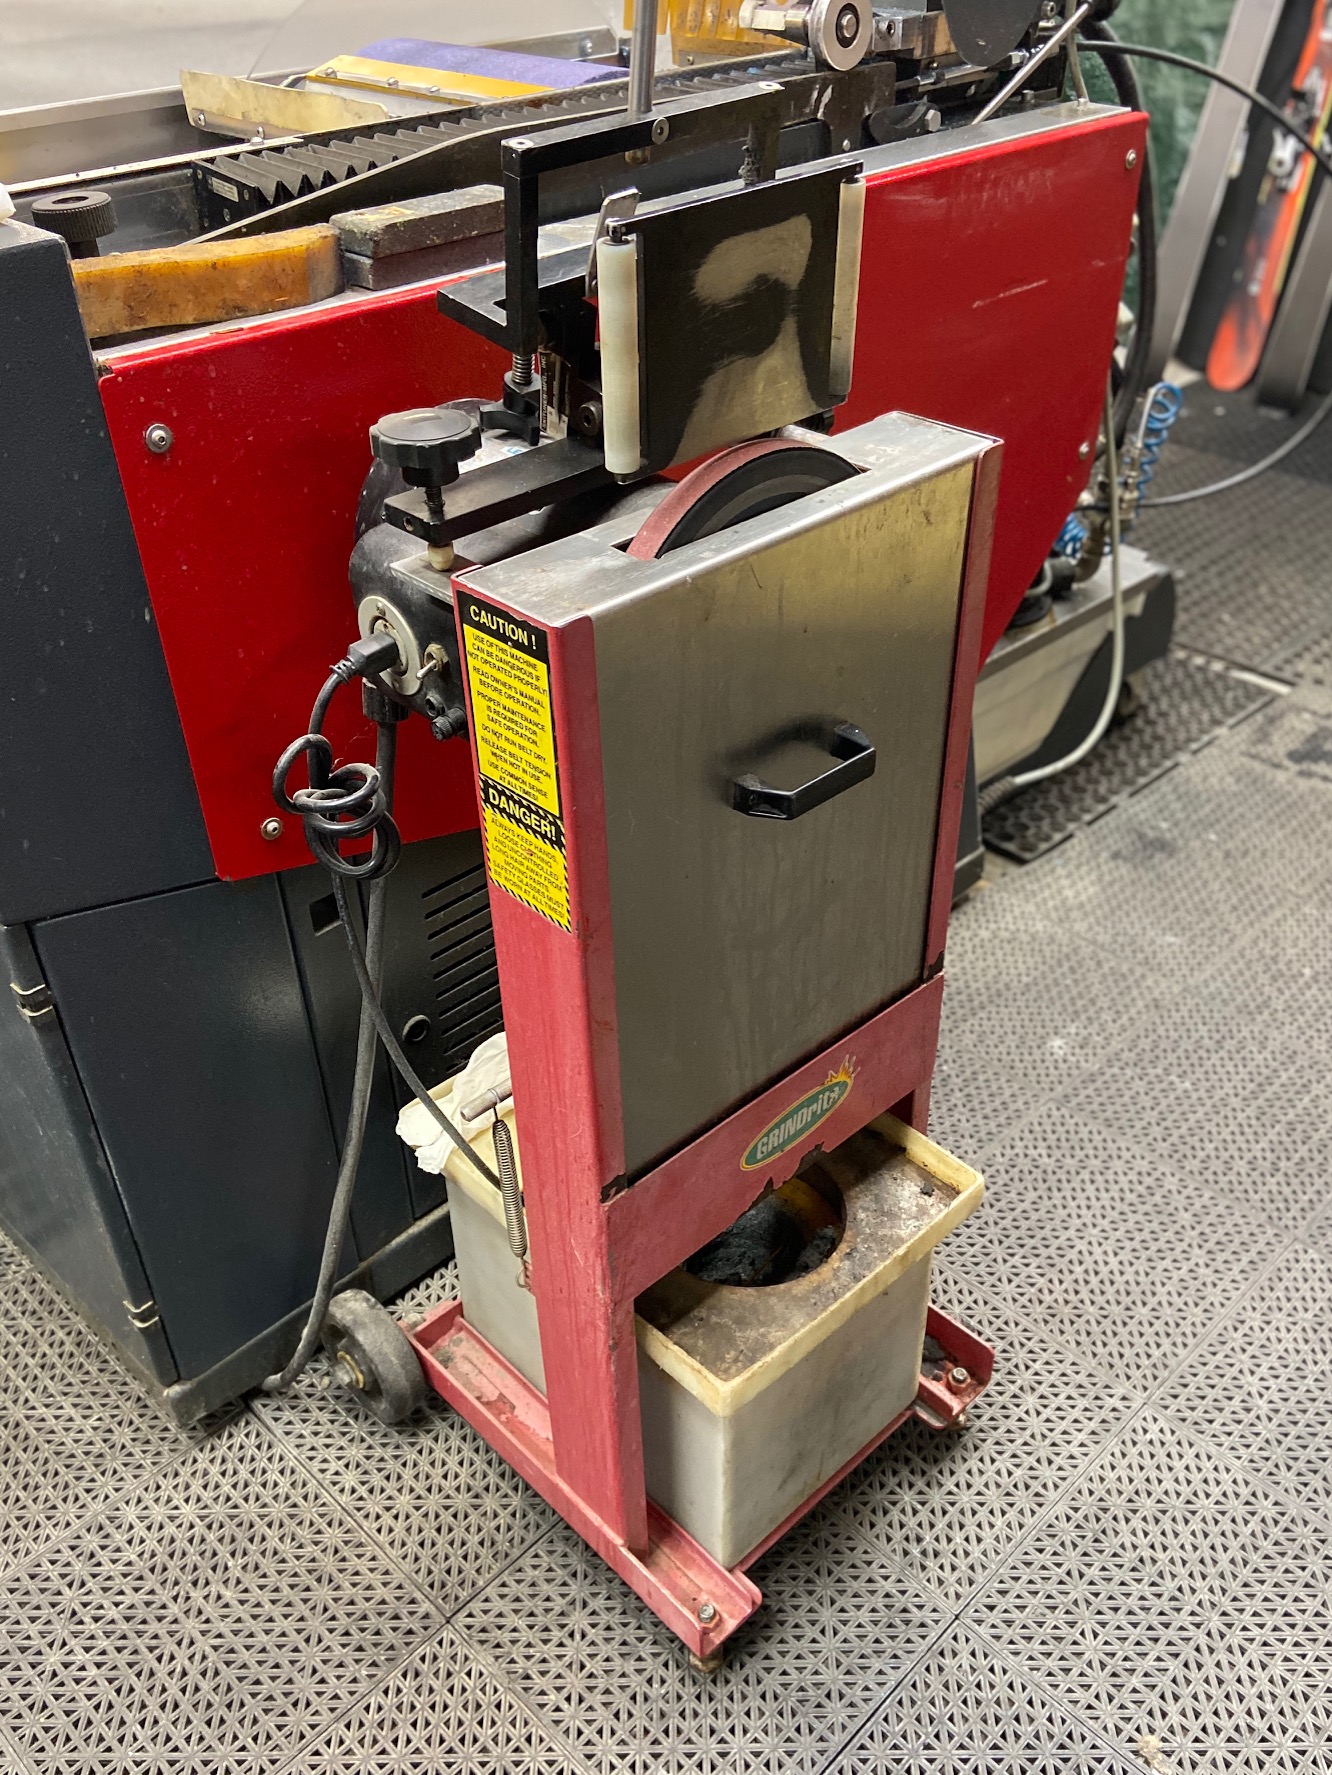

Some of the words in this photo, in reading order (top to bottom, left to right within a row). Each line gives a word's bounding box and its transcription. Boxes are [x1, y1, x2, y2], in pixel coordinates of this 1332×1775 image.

[469, 605, 528, 646] CAUTION
[472, 643, 485, 655] CAN
[486, 650, 494, 659] BE
[495, 654, 533, 680] DANGEROUS
[534, 674, 540, 683] IF
[473, 633, 485, 645] USE
[485, 640, 494, 649] OF
[495, 644, 508, 657] THIS
[509, 652, 538, 671] MACHINE
[468, 650, 479, 661] NOT
[480, 657, 512, 678] OPERATED
[513, 673, 548, 697] PROPERLY!
[473, 666, 489, 679] READ
[490, 675, 518, 695] OWNER'S
[477, 690, 501, 708] PROPER
[502, 703, 546, 732] MAINTENANCE
[479, 679, 503, 696] BEFORE
[504, 691, 541, 716] OPERATION.
[486, 705, 492, 713] IS
[492, 708, 524, 730] REQUIRED
[525, 725, 537, 737] FOR
[487, 714, 502, 727] SAFE
[481, 735, 507, 756] RELEASE
[508, 751, 523, 764] BELT
[525, 760, 551, 780] TENSION
[482, 723, 490, 733] DO
[491, 728, 503, 740] NOT
[504, 736, 516, 747] RUN
[517, 743, 532, 756] BELT
[533, 752, 547, 764] DRY.
[491, 750, 508, 764] WHEN
[508, 760, 520, 772] NOT
[522, 767, 527, 775] IN
[488, 760, 499, 771] USE
[501, 767, 527, 787] COMMON
[528, 782, 548, 799] SENSE
[499, 775, 506, 783] AT
[507, 779, 518, 790] ALL
[488, 787, 556, 841] DANGER!
[491, 818, 515, 836] ALWAYS
[516, 832, 533, 848] KEEP
[498, 829, 519, 848] LOOSE
[492, 842, 508, 858] LONG
[509, 854, 524, 868] HAIR
[526, 864, 543, 880] AWAY
[544, 876, 562, 893] FROM
[494, 835, 506, 848] AND
[507, 843, 558, 882] UNCONTROLLED
[504, 859, 527, 879] MOVING
[493, 859, 515, 879] SAFETY
[517, 875, 546, 899] GLASSES
[547, 894, 563, 911] MUST
[494, 869, 502, 878] BE
[504, 875, 522, 892] WORN
[523, 888, 531, 897] AT
[532, 893, 544, 906] ALL
